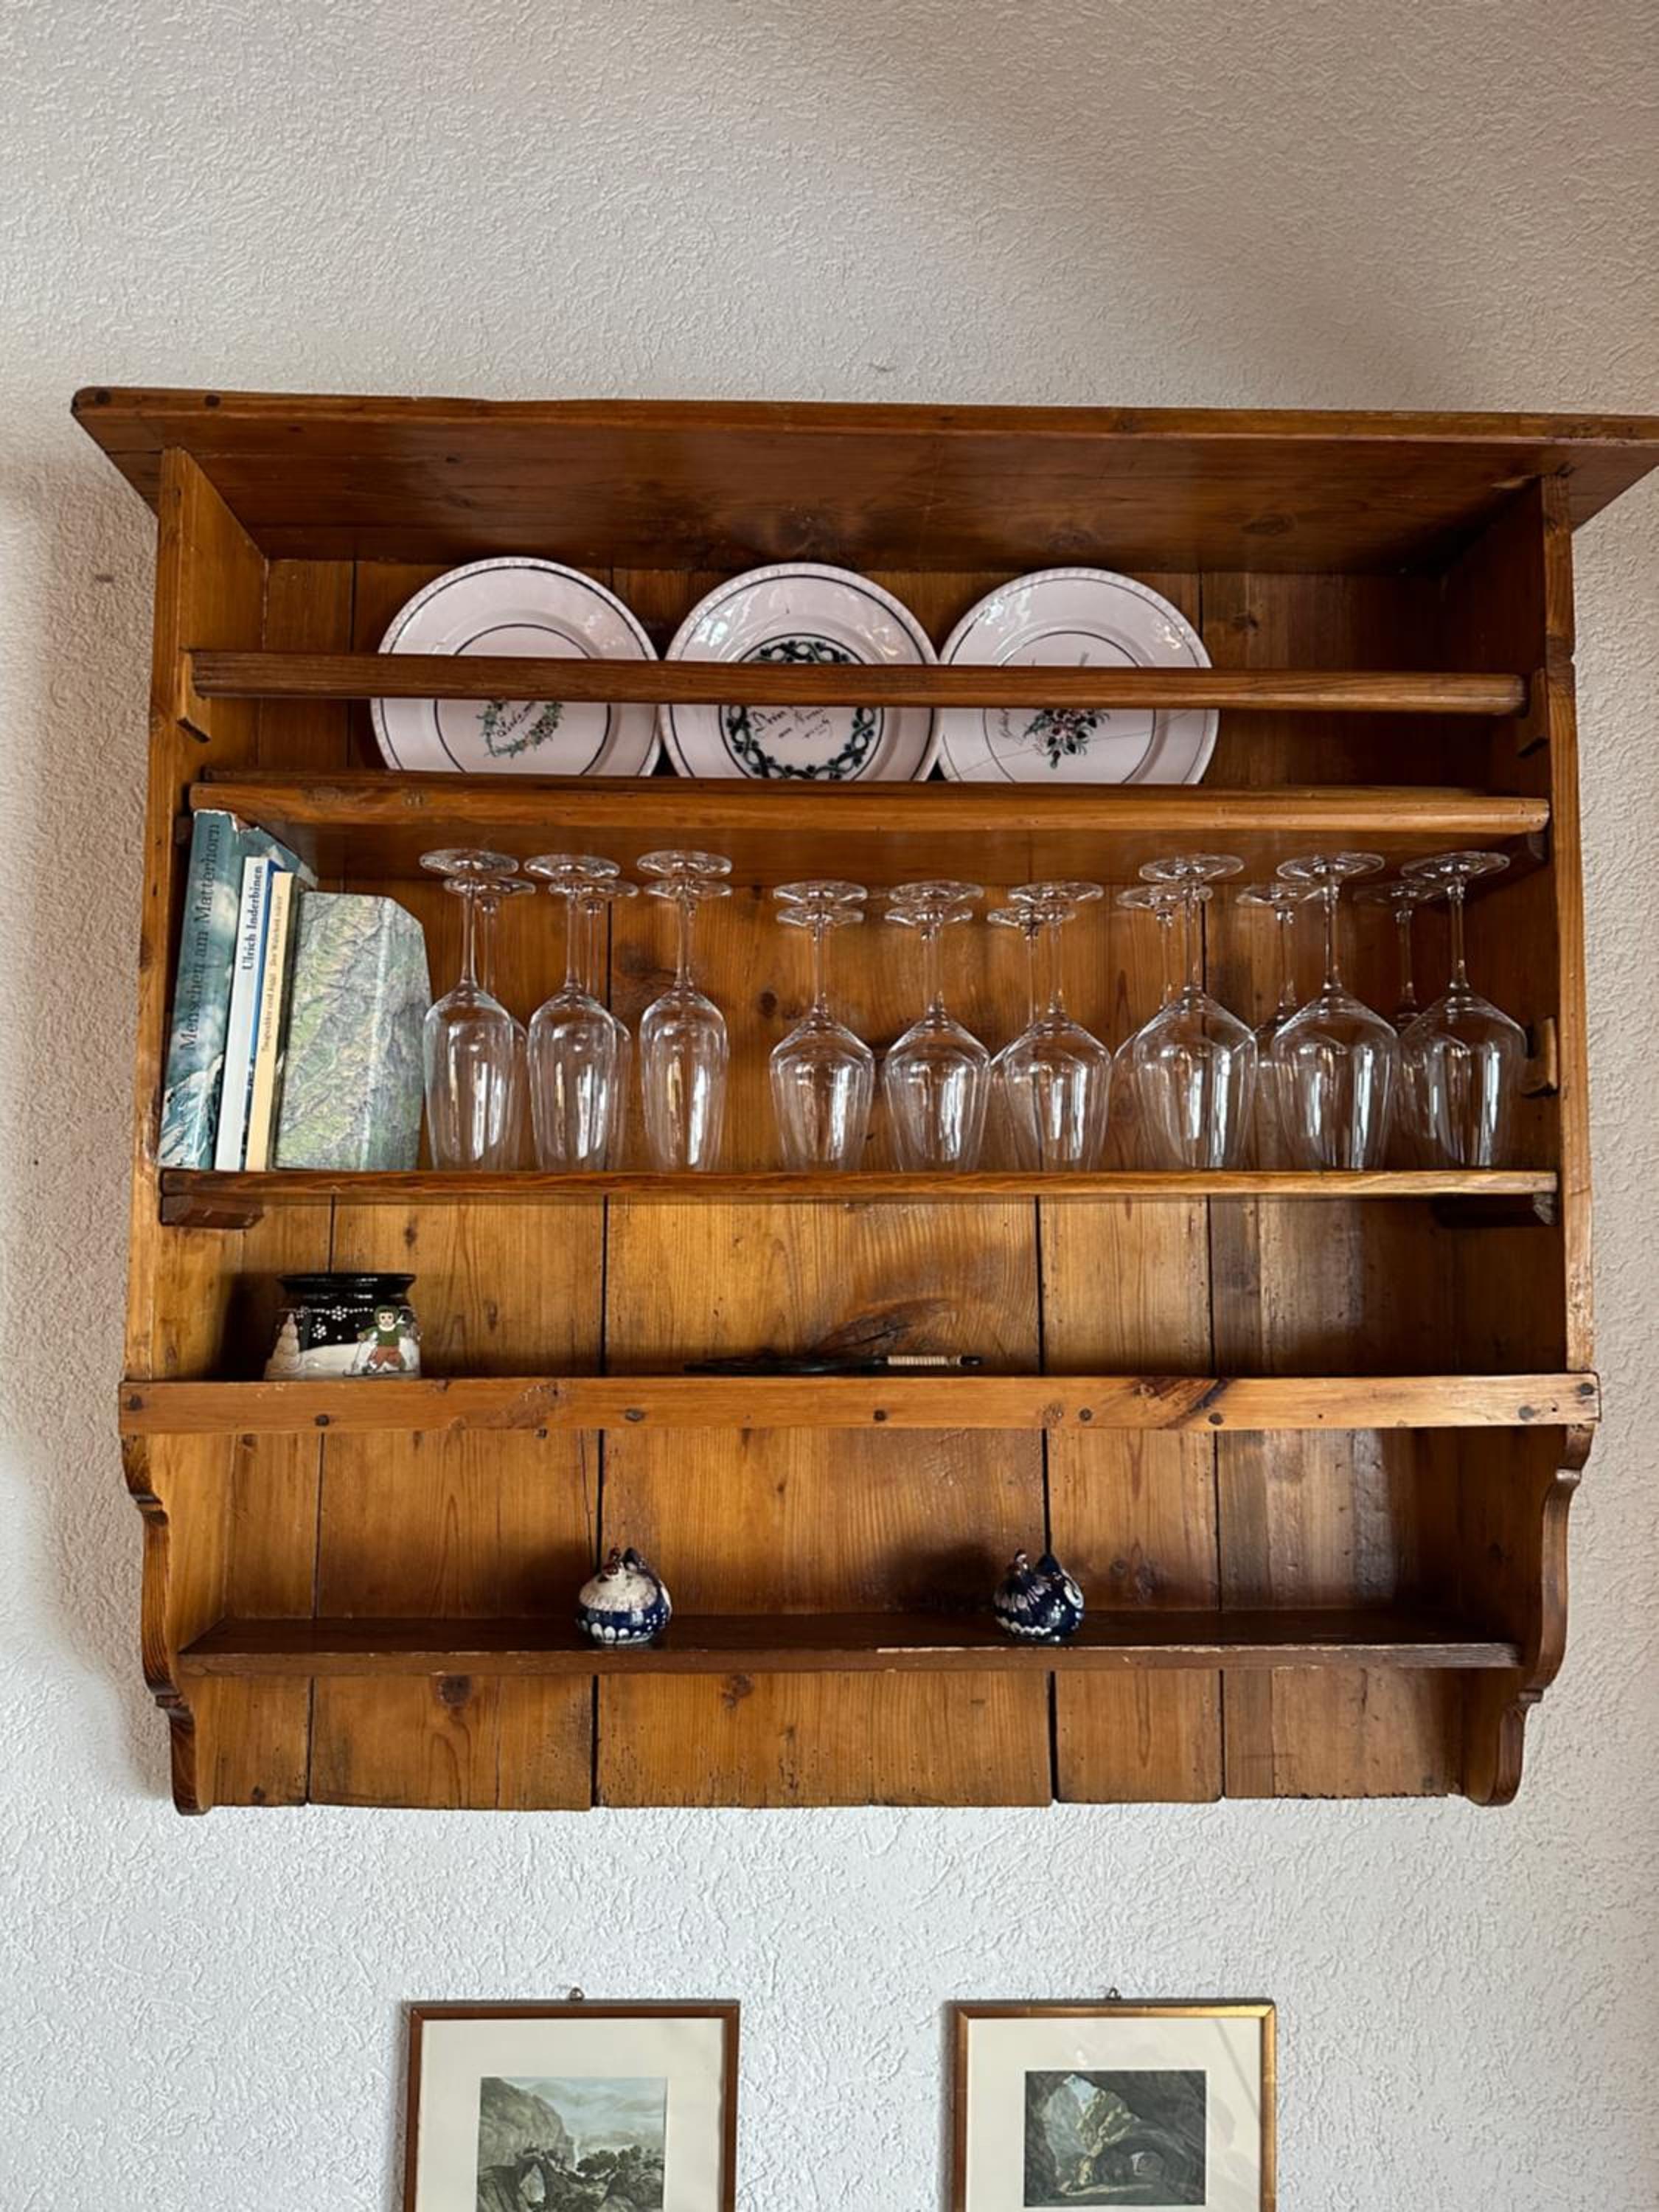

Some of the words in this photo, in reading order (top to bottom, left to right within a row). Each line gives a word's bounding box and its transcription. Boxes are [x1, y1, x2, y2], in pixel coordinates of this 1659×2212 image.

[193, 824, 220, 924] Matterhorn
[246, 865, 263, 930] Inderbinen
[195, 931, 209, 957] am
[242, 933, 257, 970] Ulrich
[179, 962, 206, 1051] Menschen
